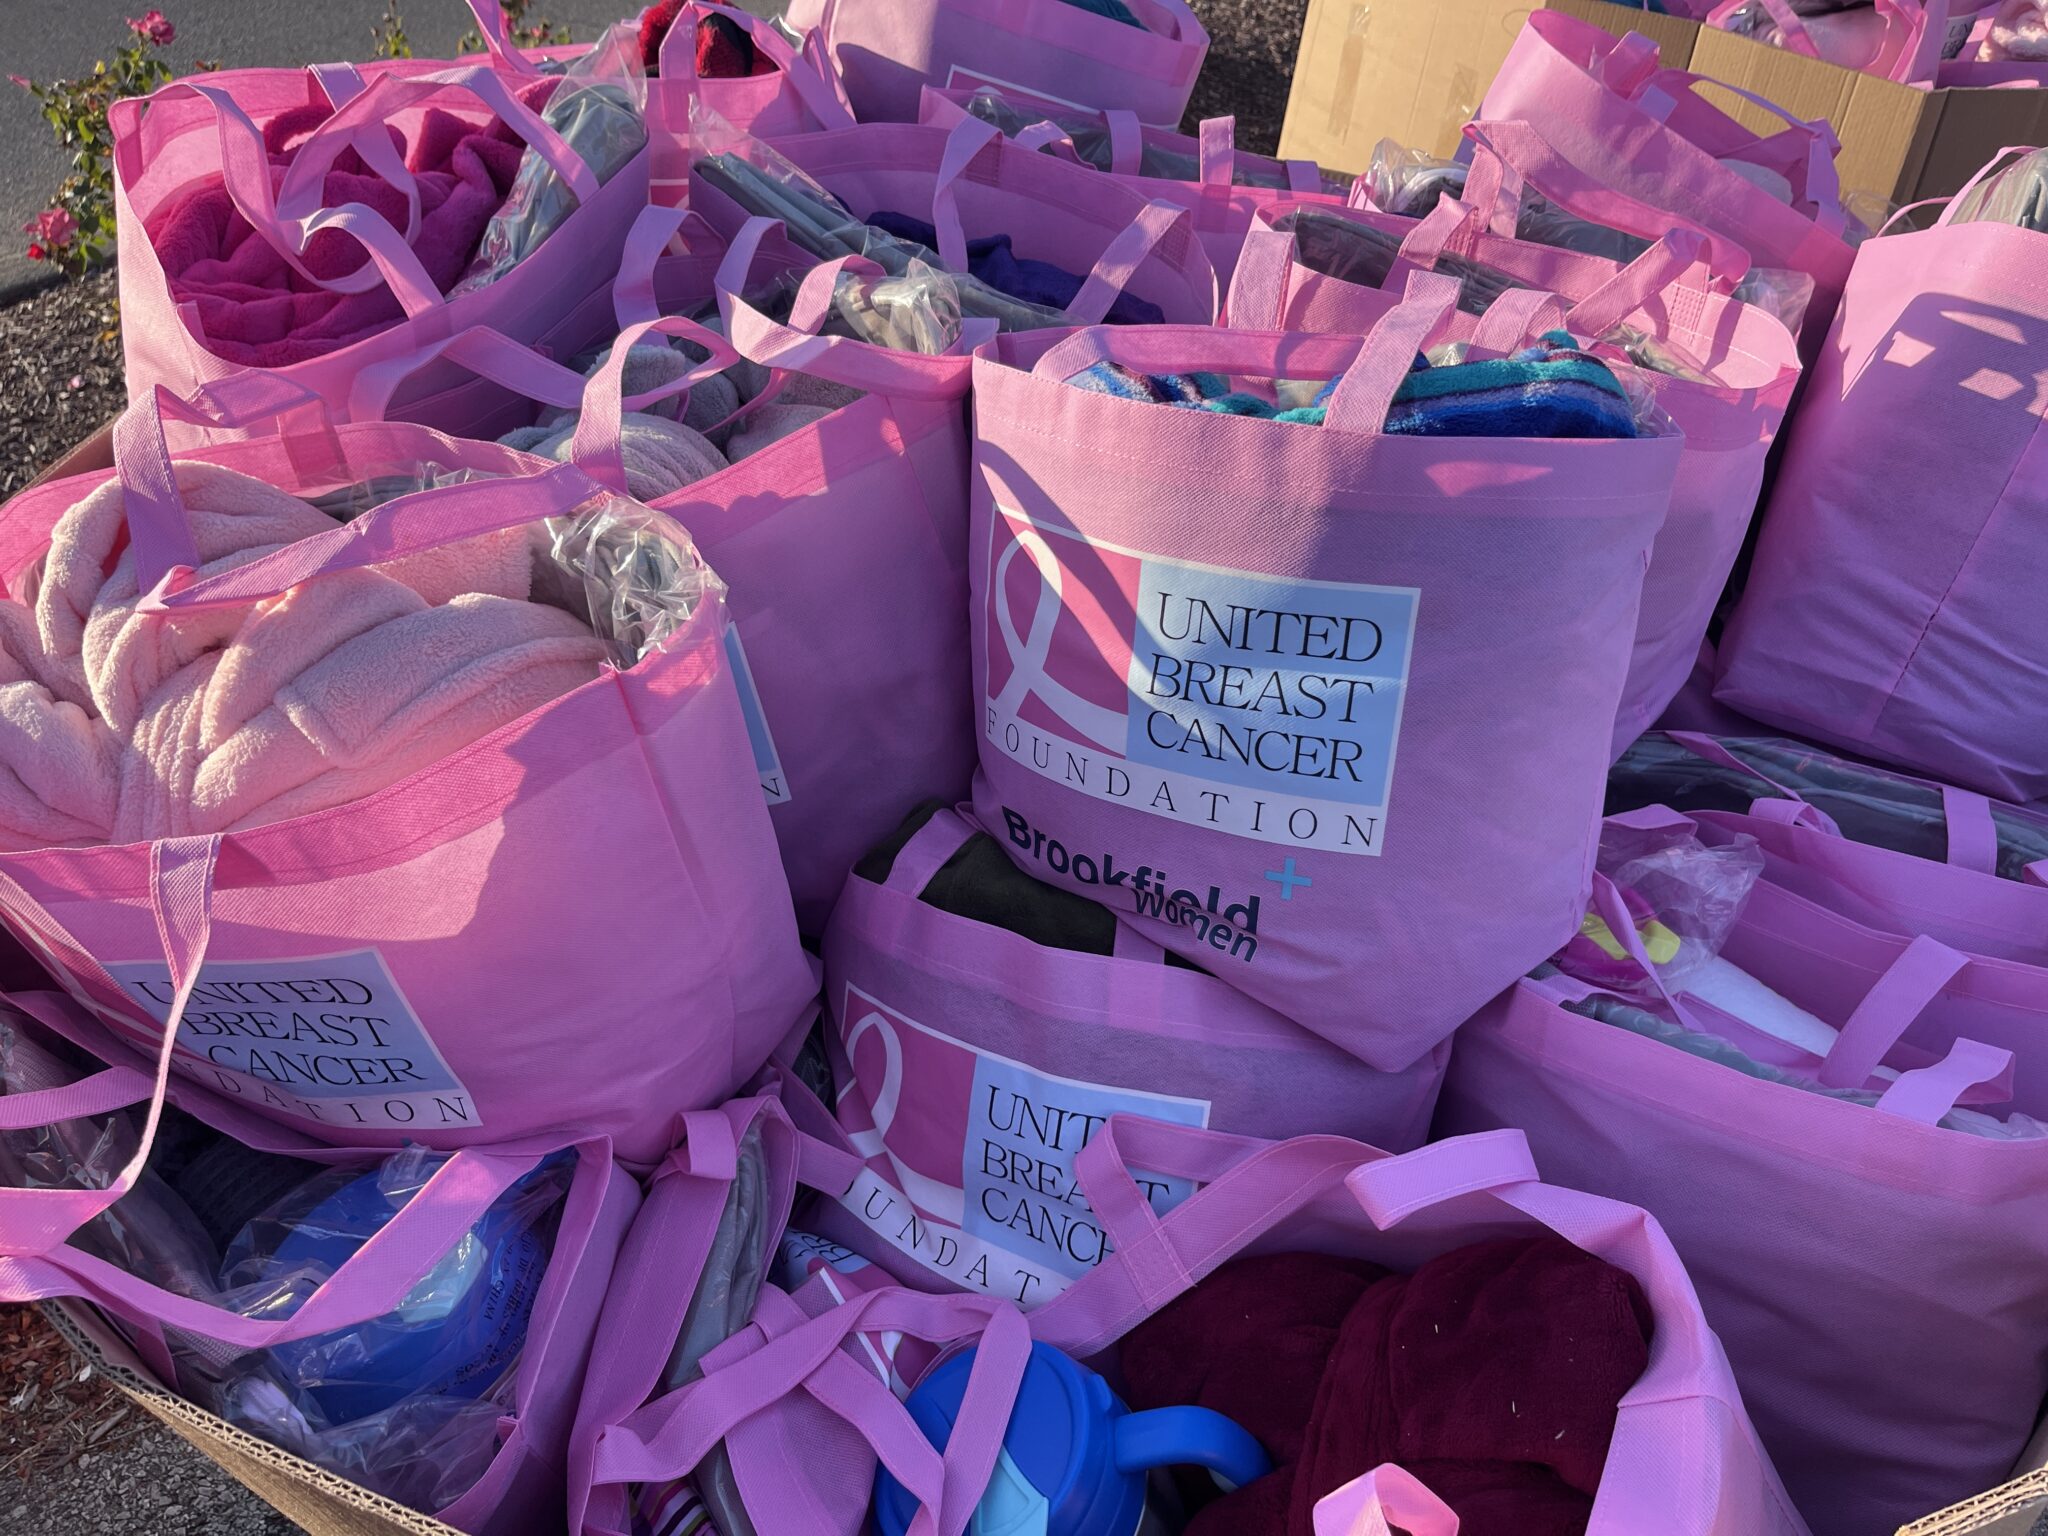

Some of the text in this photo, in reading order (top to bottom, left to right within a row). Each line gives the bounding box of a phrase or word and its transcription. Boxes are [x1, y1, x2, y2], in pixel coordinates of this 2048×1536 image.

[1158, 592, 1383, 662] UNITED
[1145, 653, 1374, 723] BREAST
[986, 706, 1380, 848] FOUNDATION
[1147, 710, 1363, 782] CANCER
[132, 978, 373, 1006] UNITED
[181, 1011, 391, 1048] BREAST
[208, 1044, 427, 1086] CANCER
[988, 1085, 1107, 1154] UNIT
[980, 1138, 1170, 1213] BRET
[981, 1187, 1115, 1266] CANC
